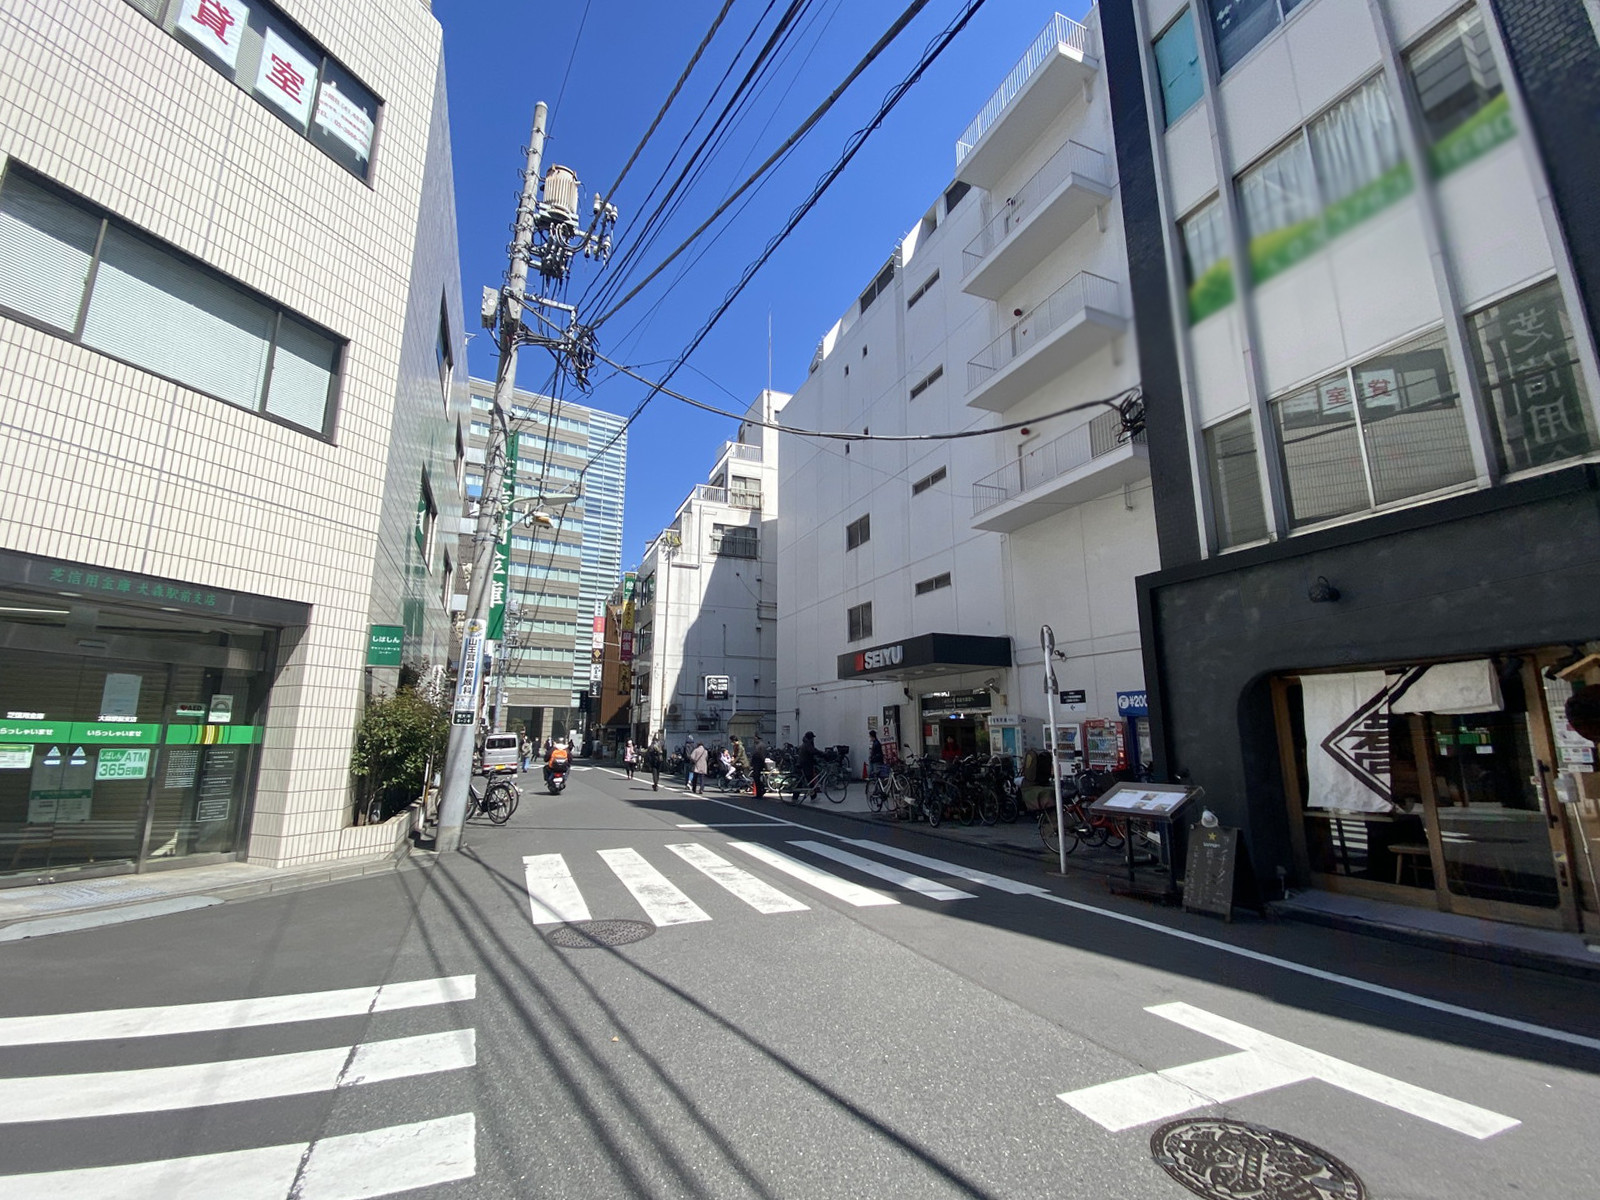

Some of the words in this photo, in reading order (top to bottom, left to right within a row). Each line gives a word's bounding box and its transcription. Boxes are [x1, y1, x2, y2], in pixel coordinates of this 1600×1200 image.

[265, 53, 305, 104] 室
[50, 567, 131, 592] 芝信用金庫
[864, 645, 903, 670] SEIYU
[87, 729, 143, 737] いらっしゃいませ
[125, 752, 147, 763] ATM
